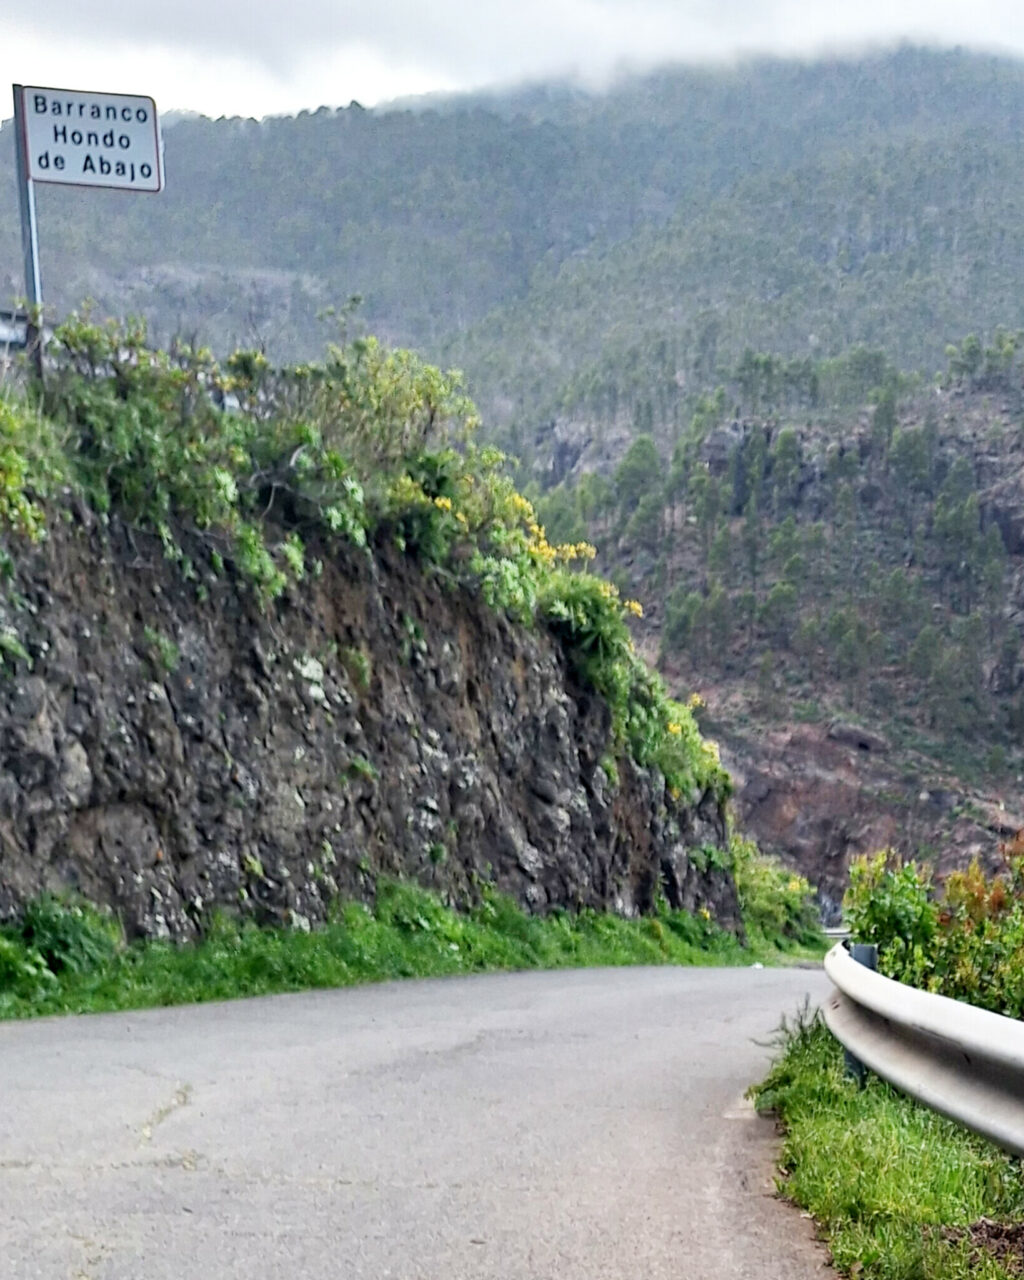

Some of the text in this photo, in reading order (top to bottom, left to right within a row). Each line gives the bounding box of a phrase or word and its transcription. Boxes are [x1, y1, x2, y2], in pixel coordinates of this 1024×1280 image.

[34, 95, 148, 124] Barranco
[53, 125, 130, 150] Hondo
[38, 151, 152, 182] de Abajo
